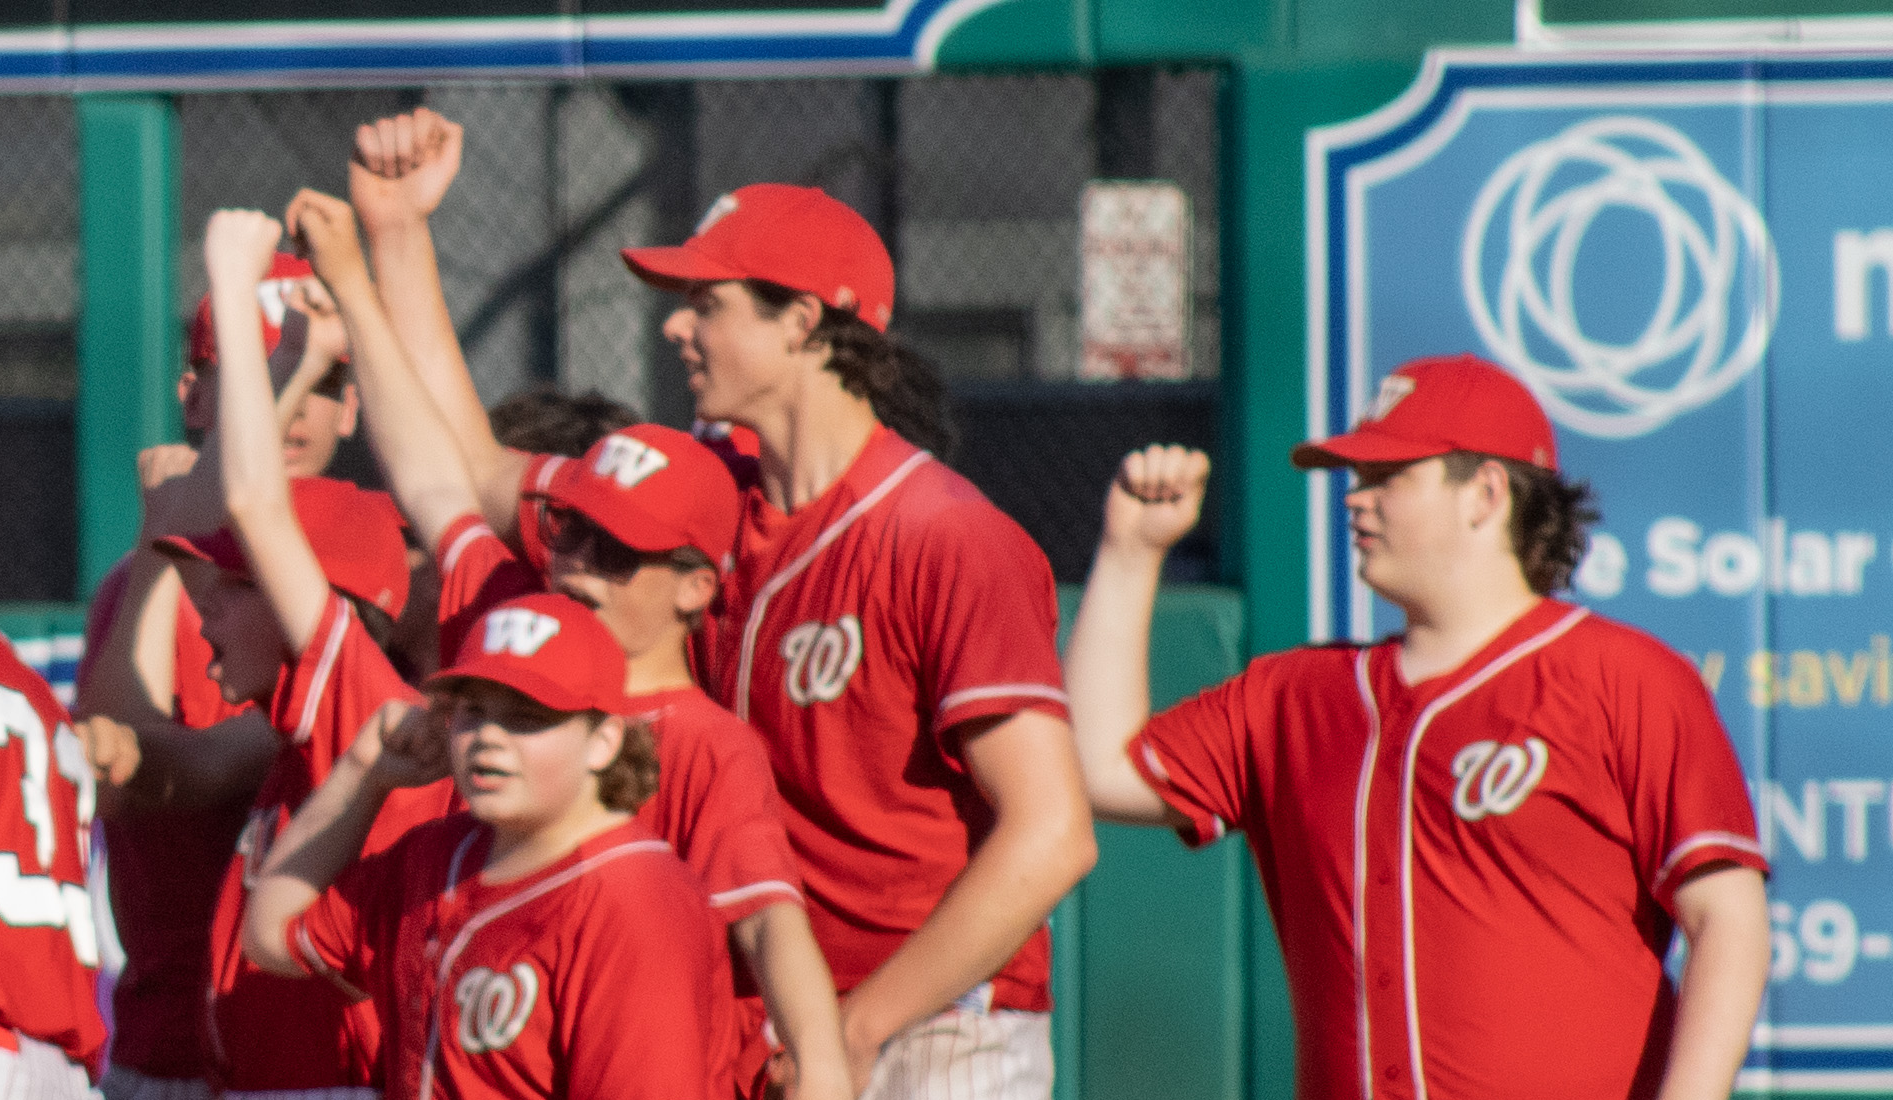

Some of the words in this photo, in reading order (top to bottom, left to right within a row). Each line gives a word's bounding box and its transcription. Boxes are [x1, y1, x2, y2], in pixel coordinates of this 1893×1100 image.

[594, 434, 669, 490] W
[1646, 515, 1876, 598] Solar
[482, 606, 561, 656] W
[781, 614, 863, 707] W
[1450, 736, 1548, 821] W
[454, 962, 539, 1054] W
